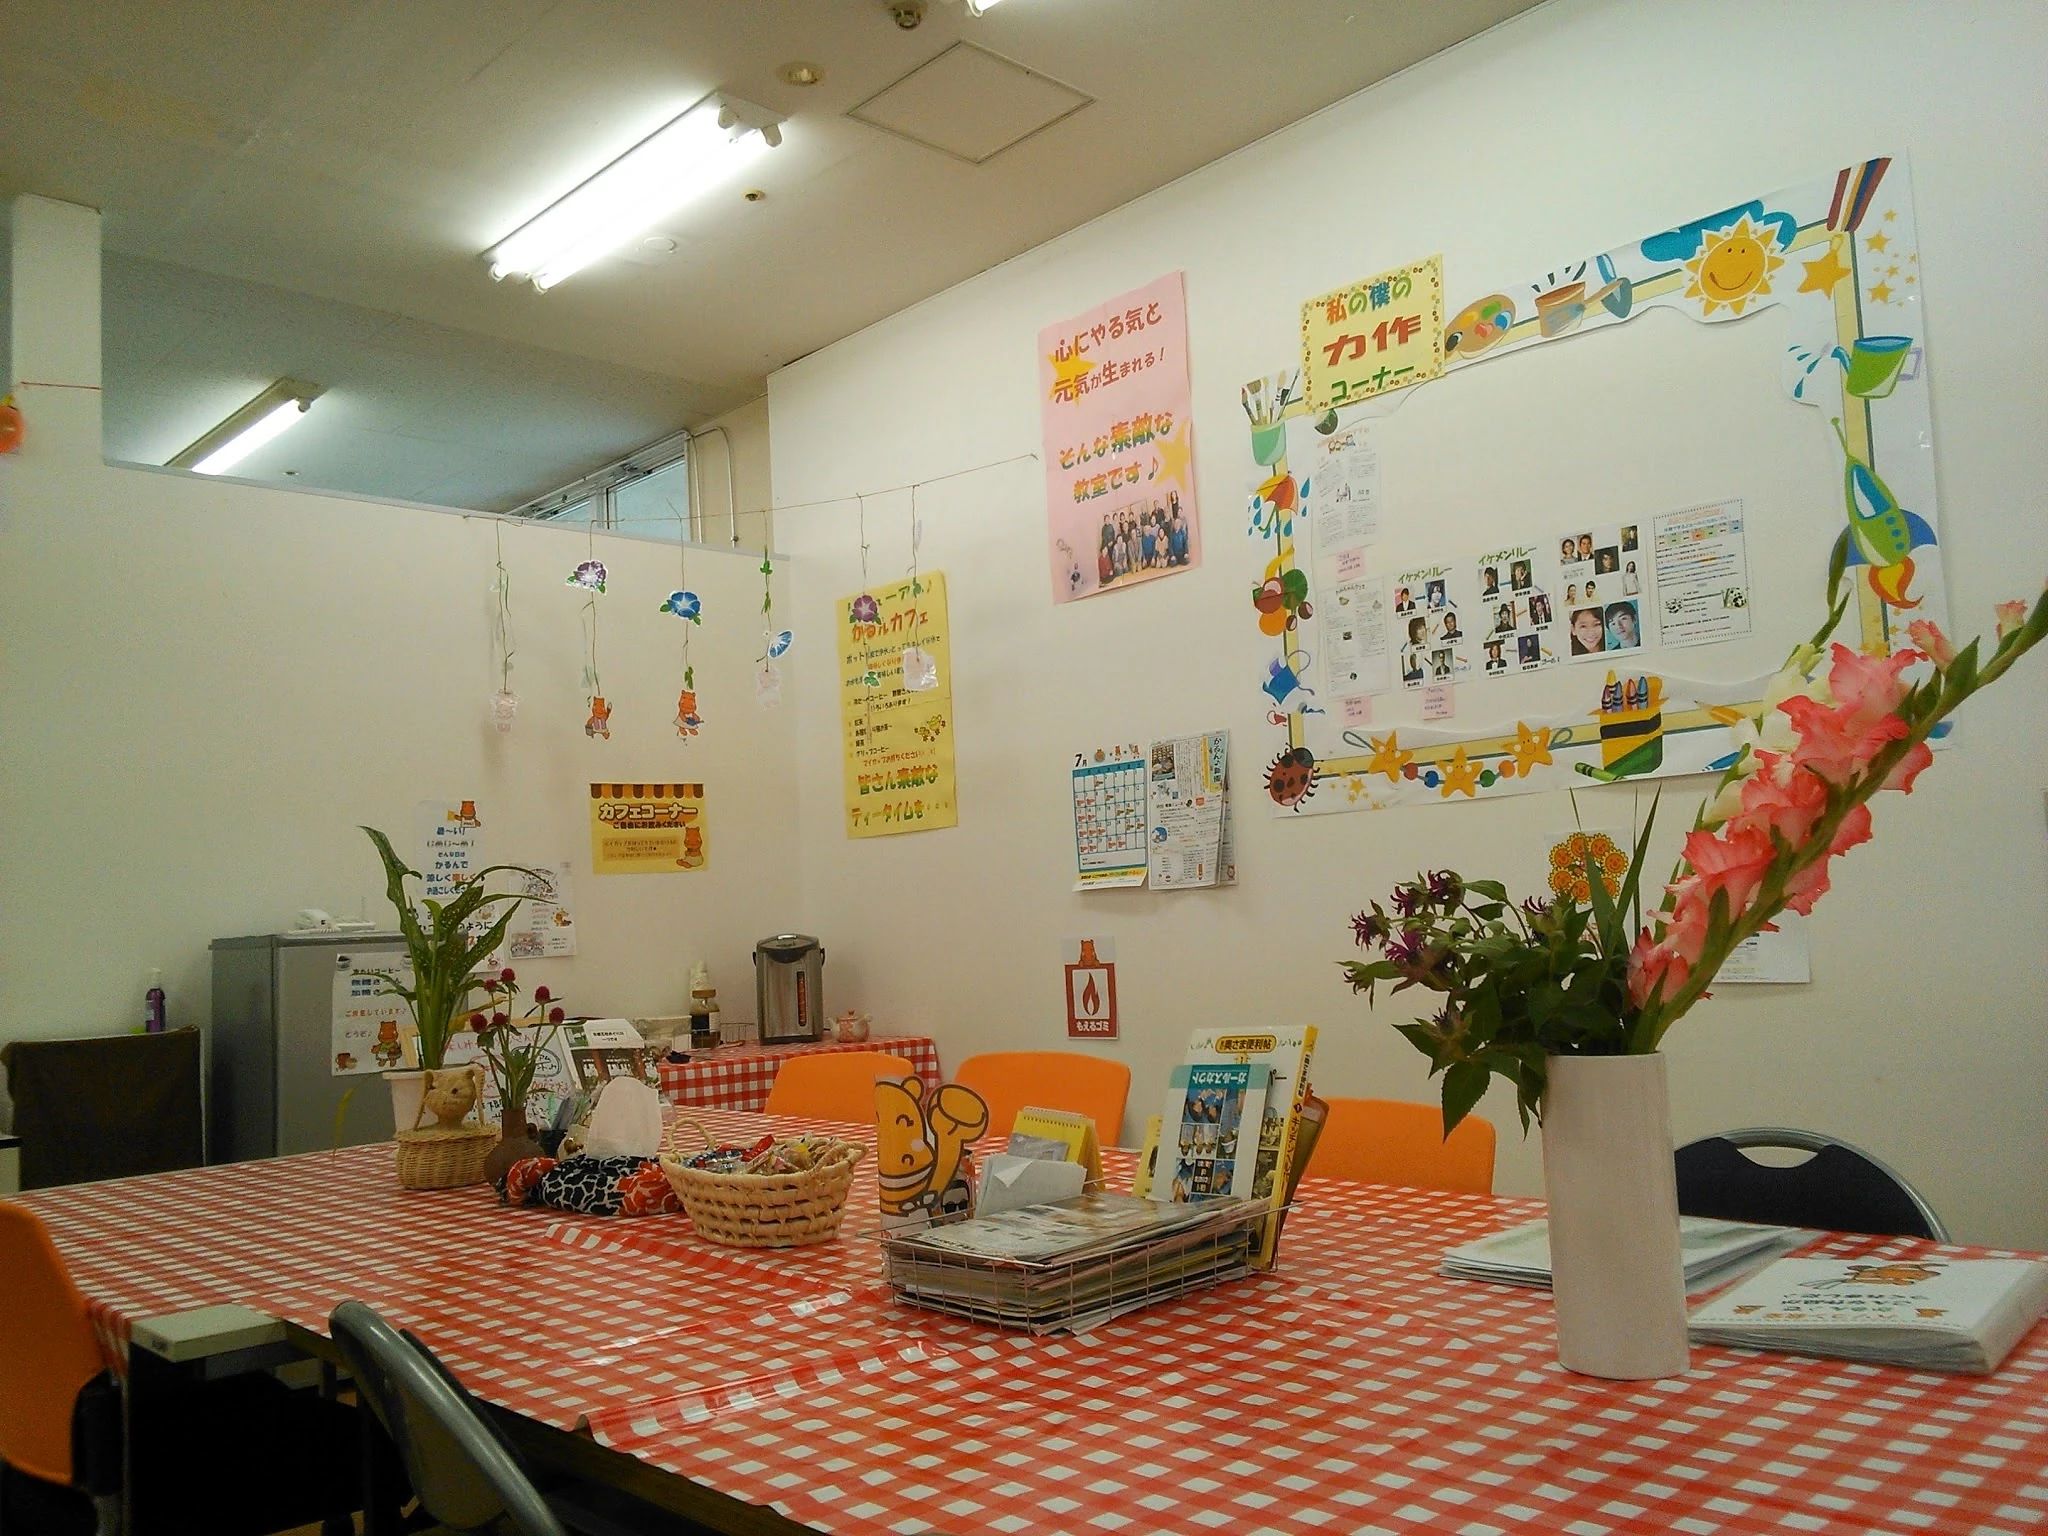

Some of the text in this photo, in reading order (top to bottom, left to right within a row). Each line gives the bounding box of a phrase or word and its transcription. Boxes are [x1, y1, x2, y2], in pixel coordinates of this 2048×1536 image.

[1326, 276, 1412, 326] 私の僕の
[1055, 302, 1162, 362] 心にやる気と
[1323, 315, 1421, 367] 力作
[1331, 366, 1414, 404] コーナー
[1059, 412, 1173, 470] そんな素敵な
[858, 763, 938, 795] 皆さん素敵な
[599, 802, 698, 821] カフェコーナー
[435, 861, 468, 869] かるんで
[1076, 1020, 1109, 1032] もえるゴミ
